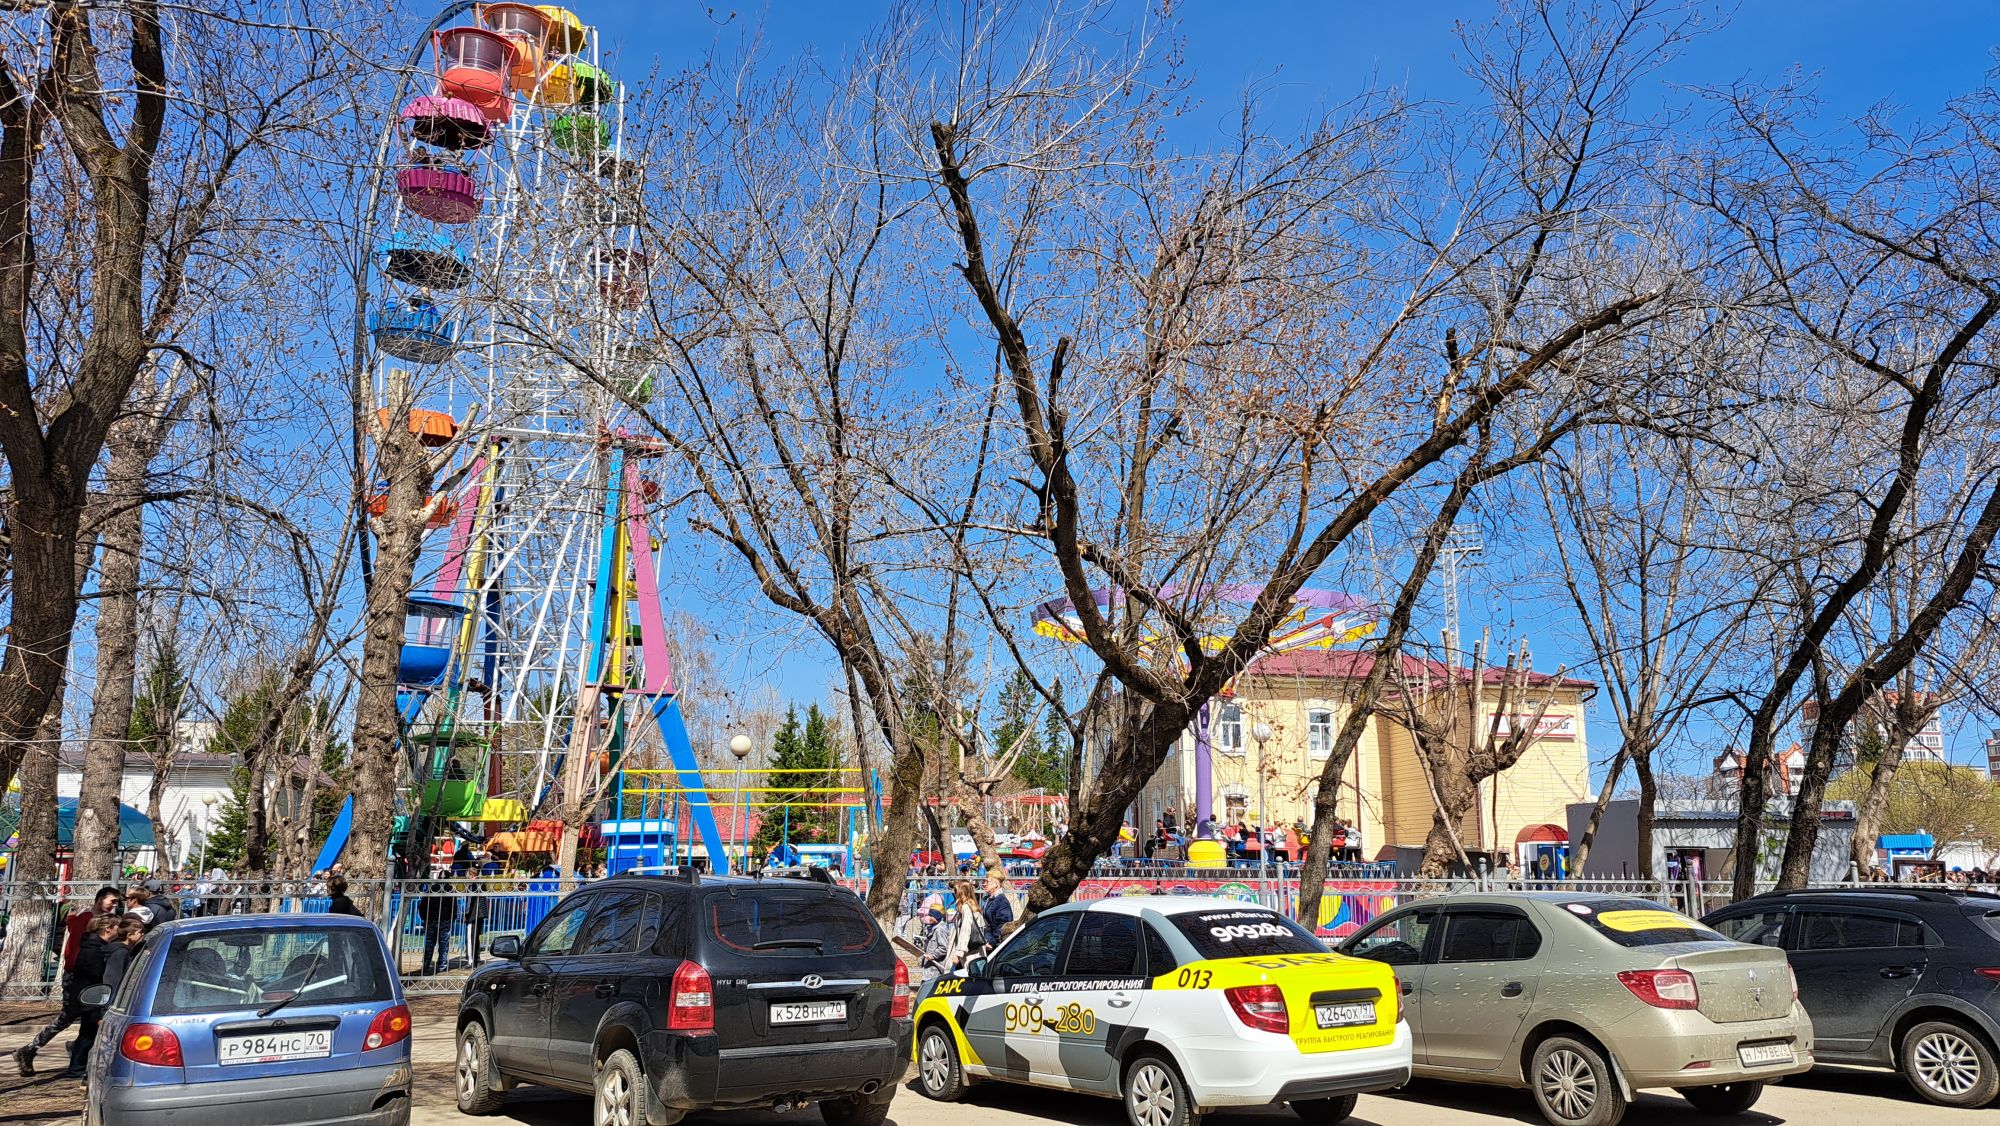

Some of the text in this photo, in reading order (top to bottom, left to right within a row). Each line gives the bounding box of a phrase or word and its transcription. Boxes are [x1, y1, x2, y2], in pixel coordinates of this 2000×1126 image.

[1210, 922, 1294, 943] 909280
[933, 978, 966, 995] БАРС
[1177, 968, 1213, 989] 013
[1010, 982, 1038, 993] ГРУППА
[1004, 1001, 1096, 1035] 909-280
[307, 1033, 325, 1046] 70
[1295, 1036, 1322, 1045] ГРУППА
[1323, 1033, 1355, 1043] БЫСТРОГО
